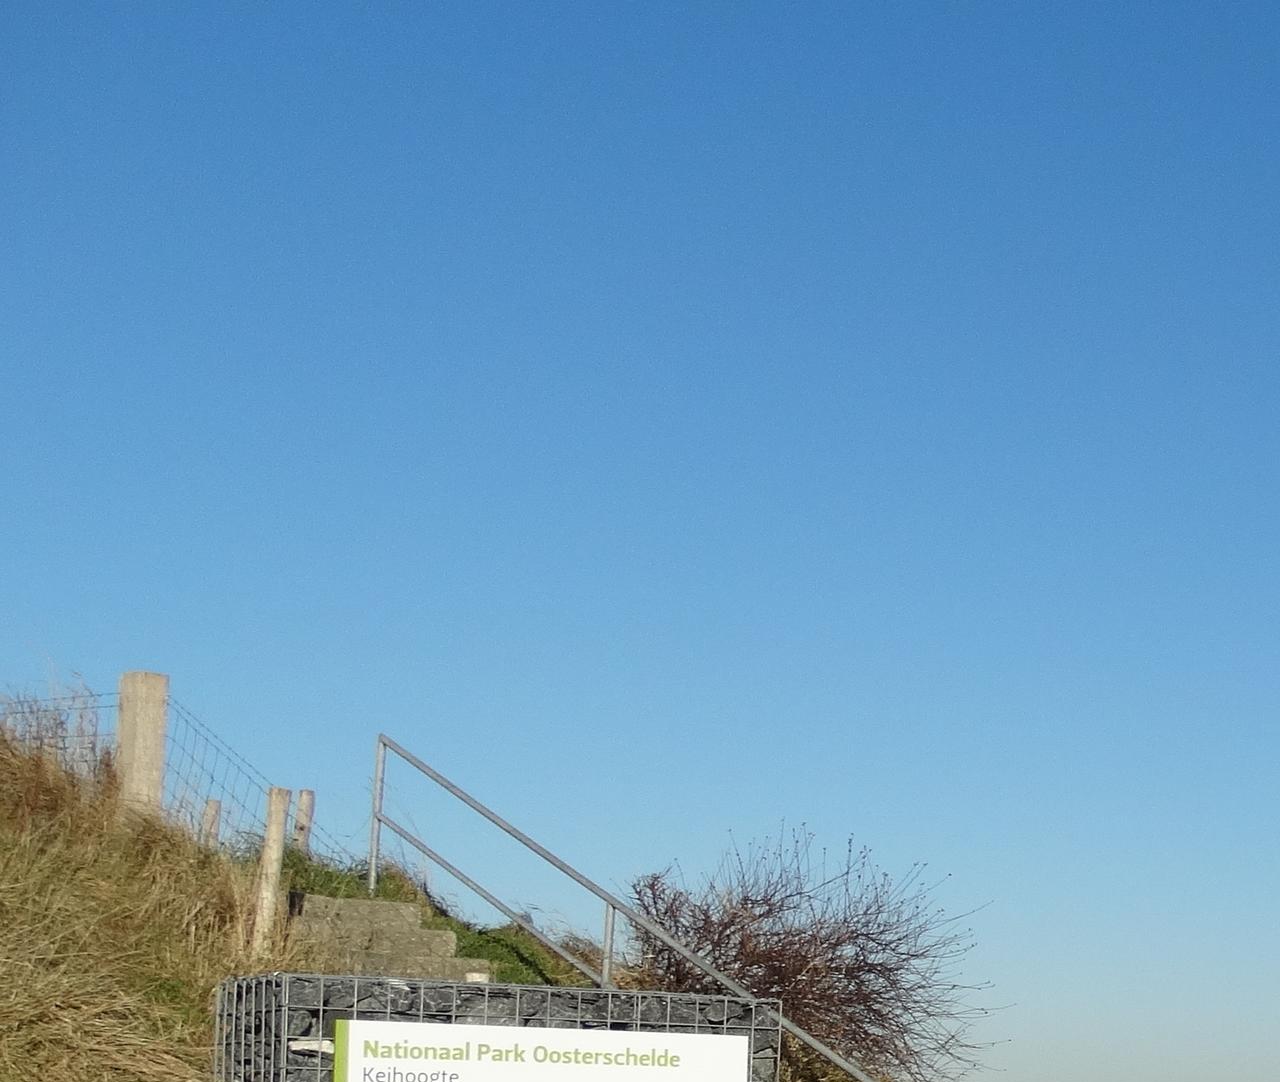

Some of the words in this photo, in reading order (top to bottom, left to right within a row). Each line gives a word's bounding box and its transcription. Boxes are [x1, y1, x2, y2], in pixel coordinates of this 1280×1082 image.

[363, 1039, 471, 1062] Nationaal
[477, 1043, 526, 1064] Park
[533, 1045, 681, 1068] Oosterschelde
